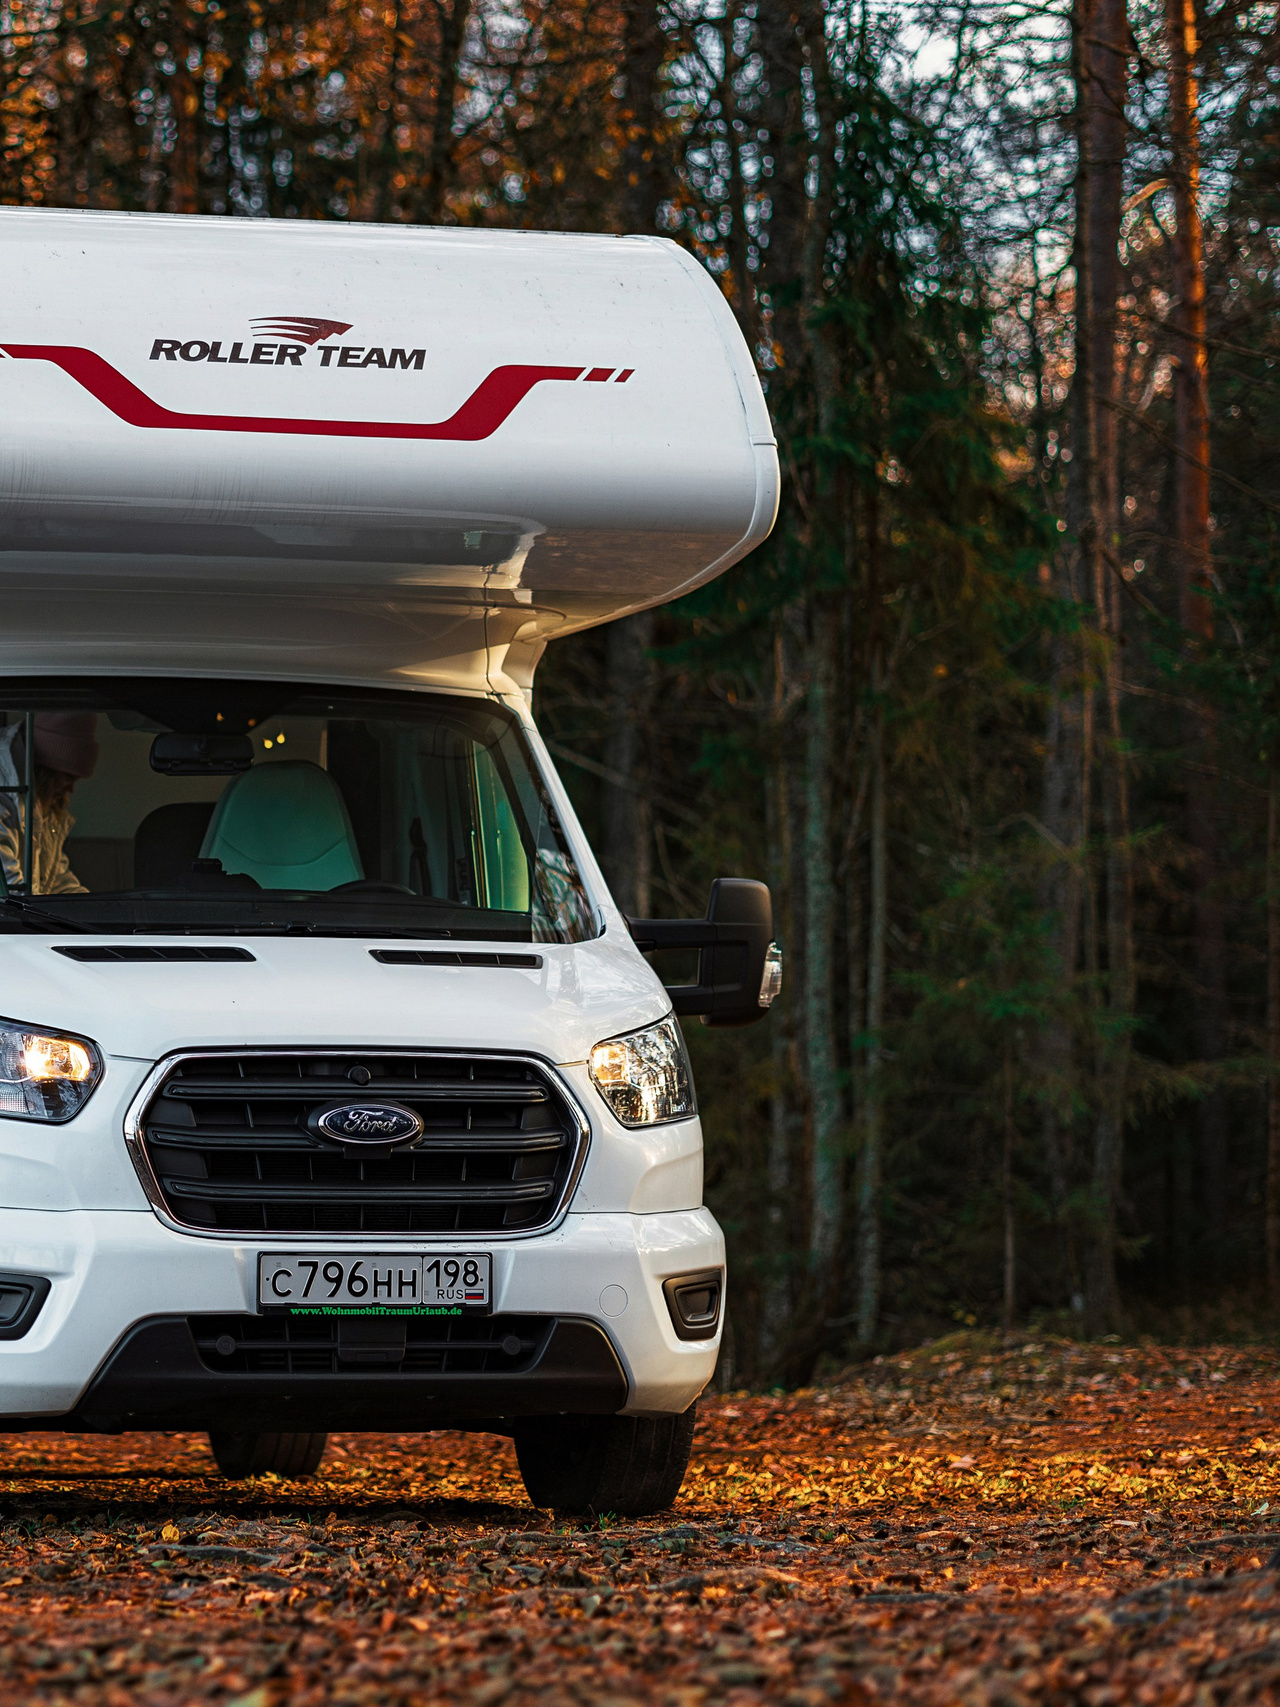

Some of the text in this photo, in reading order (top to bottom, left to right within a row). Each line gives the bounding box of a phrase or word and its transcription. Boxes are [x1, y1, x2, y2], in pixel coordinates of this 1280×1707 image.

[148, 338, 427, 370] ROLLER TEAM
[343, 1109, 397, 1133] Ford
[426, 1259, 480, 1288] 198
[436, 1288, 464, 1300] RUS
[290, 1306, 463, 1316] www.WohnmobilTraumUrlaub.de
